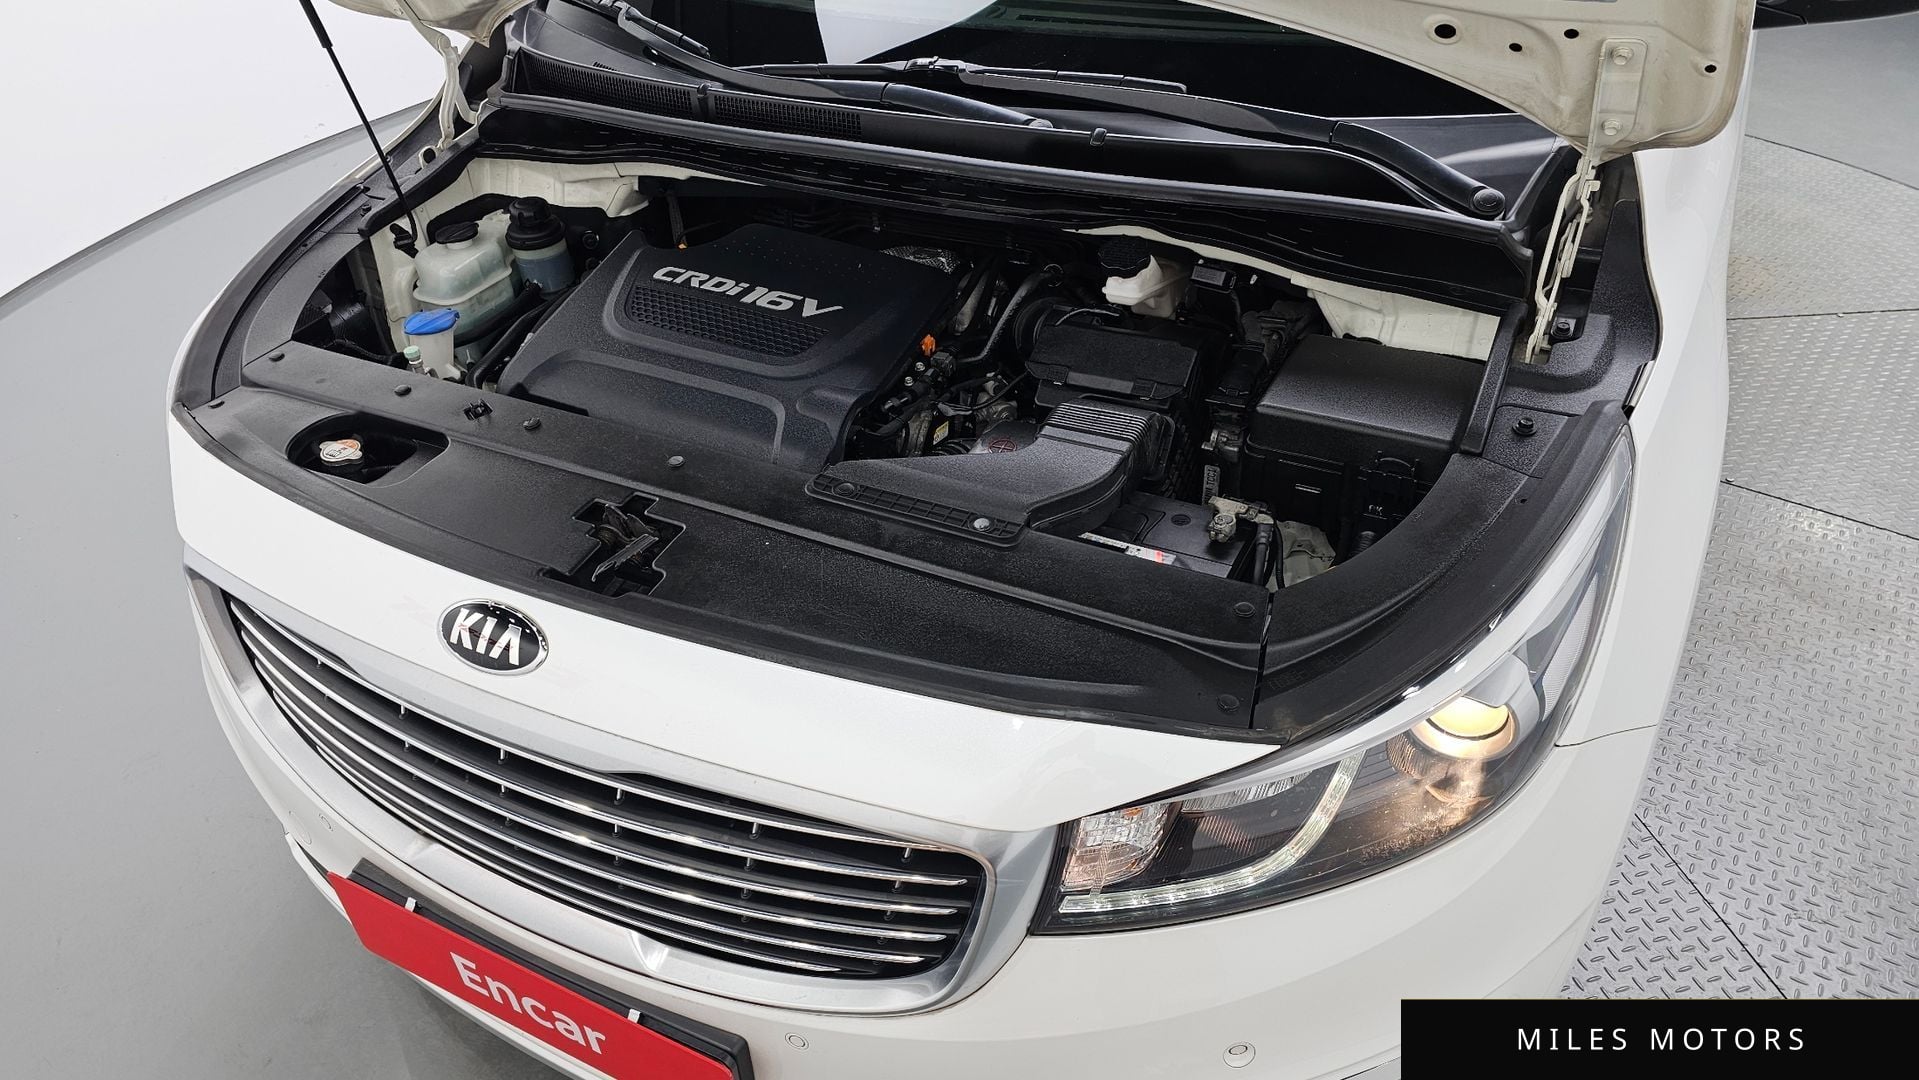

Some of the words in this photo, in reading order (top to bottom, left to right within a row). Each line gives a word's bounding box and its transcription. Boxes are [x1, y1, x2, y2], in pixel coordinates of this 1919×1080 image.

[652, 265, 750, 297] CRDi
[739, 286, 844, 318] 16V
[449, 607, 523, 666] KIA
[450, 951, 606, 1055] Encar
